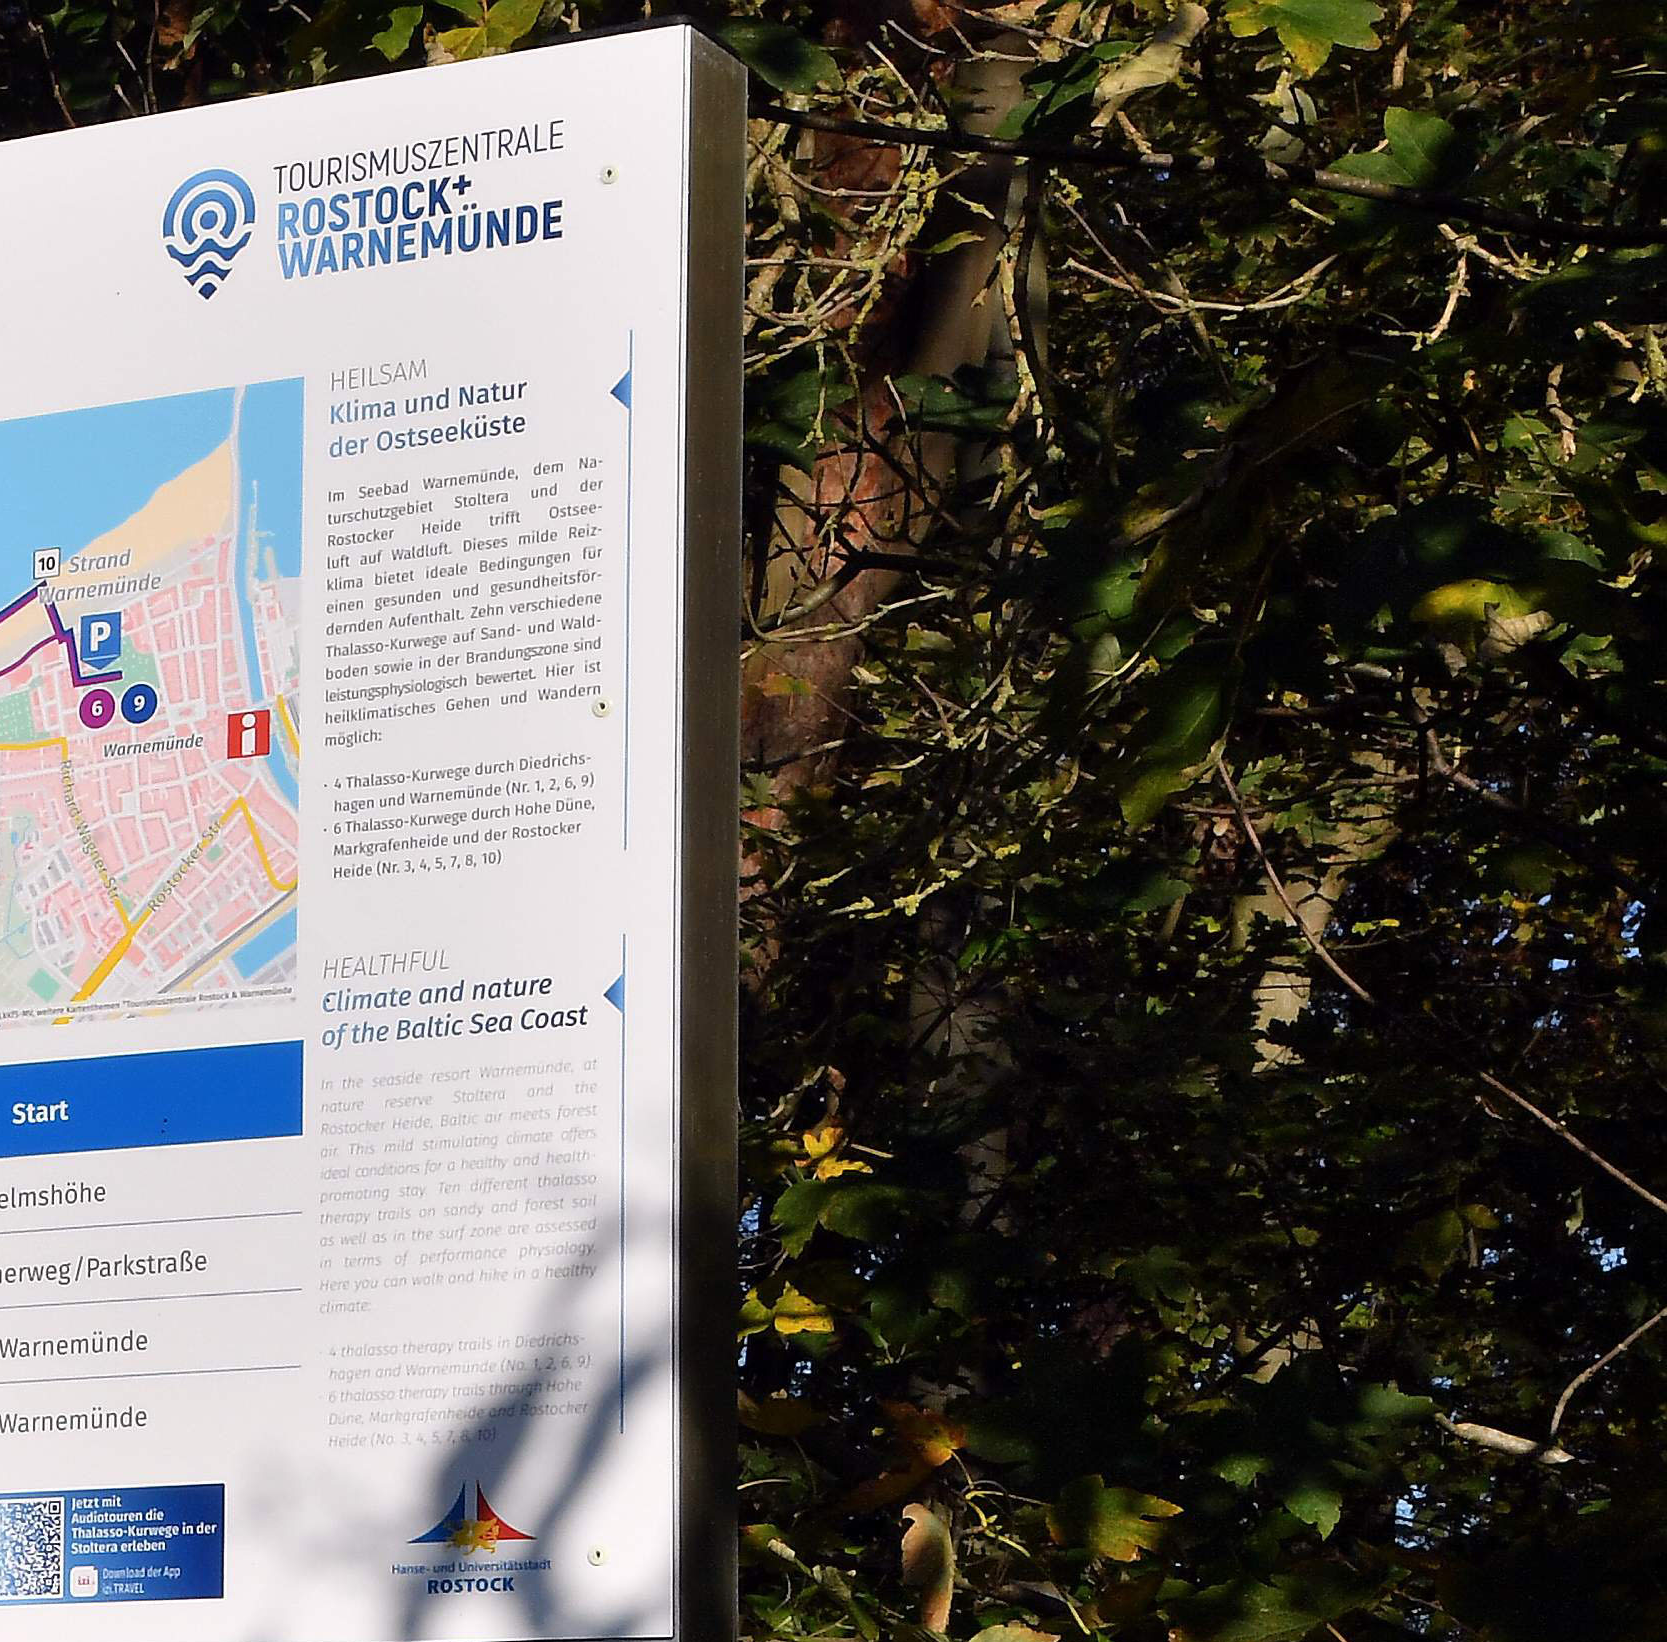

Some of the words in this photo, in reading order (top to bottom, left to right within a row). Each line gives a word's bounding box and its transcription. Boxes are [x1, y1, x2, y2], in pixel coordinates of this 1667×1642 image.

[274, 120, 563, 193] TOURISMUSZENTRALE
[279, 175, 477, 240] ROSTOCK+
[279, 202, 562, 279] WARNEMÜNDE
[332, 359, 426, 391] HEILSAM
[331, 400, 395, 424] Klima
[406, 388, 449, 414] und
[459, 382, 527, 407] Natur
[330, 437, 368, 457] der
[377, 415, 525, 451] Ostseeküste
[329, 492, 344, 502] Im
[359, 480, 408, 499] Seebad
[423, 467, 518, 489] Warnemünde,
[534, 463, 563, 475] dem
[579, 458, 602, 469] Na-
[328, 501, 432, 525] turschutzgebiet
[455, 493, 508, 508] Stoltera
[531, 483, 557, 498] und
[580, 480, 603, 492] der
[328, 529, 394, 547] Rostocker
[422, 520, 461, 534] Heide
[490, 512, 520, 526] trifft
[550, 504, 602, 518] Ostsee-
[37, 556, 56, 571] 10
[68, 549, 131, 573] Strand
[39, 573, 162, 603] Warnemünde
[92, 701, 103, 717] 6
[133, 695, 146, 711] 9
[103, 734, 204, 758] Warnemünde
[334, 779, 341, 788] 4
[347, 767, 470, 788] Thalasso-Kurwege
[475, 760, 514, 775] durch
[520, 753, 590, 770] Diedrichs-
[324, 950, 449, 979] HEALTHFUL
[323, 989, 411, 1012] Climate
[419, 980, 464, 1004] and
[473, 978, 552, 1000] nature
[323, 1023, 348, 1049] of
[353, 1022, 388, 1043] the
[397, 1013, 463, 1040] Baltic
[470, 1014, 512, 1034] Sea
[521, 1006, 588, 1029] Coast
[13, 1101, 68, 1124] Start
[0, 1330, 147, 1358] Warnemünde
[71, 1497, 100, 1512] Jetzt
[102, 1495, 122, 1507] mit
[71, 1511, 143, 1525] Audiotouren
[145, 1508, 165, 1520] die
[71, 1525, 180, 1539] Thalasso-Kurwege
[182, 1521, 194, 1534] in
[196, 1521, 218, 1534] der
[70, 1541, 118, 1555] Stoltera
[120, 1540, 166, 1553] erleben
[102, 1567, 146, 1579] Download
[147, 1566, 162, 1577] der
[163, 1566, 181, 1579] App
[427, 1577, 515, 1595] ROSTOCK
